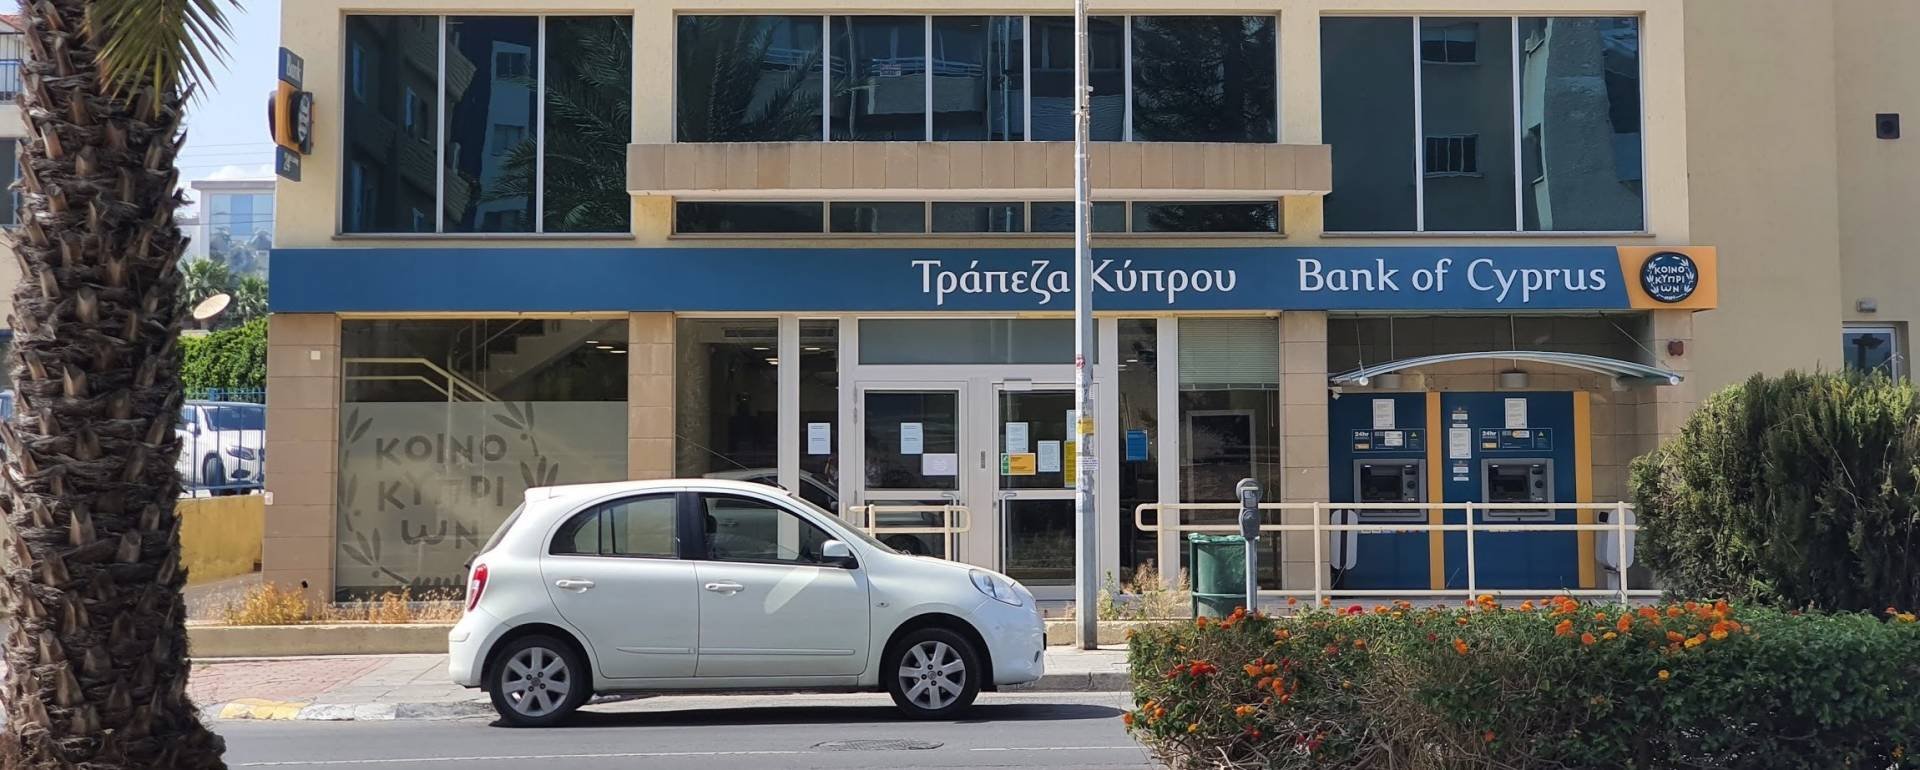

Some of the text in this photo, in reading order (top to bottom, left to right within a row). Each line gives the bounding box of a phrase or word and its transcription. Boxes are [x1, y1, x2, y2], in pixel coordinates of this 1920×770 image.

[911, 259, 1237, 306] Τράπεζα Κύπρου
[1297, 258, 1606, 304] Bank of Cyprus
